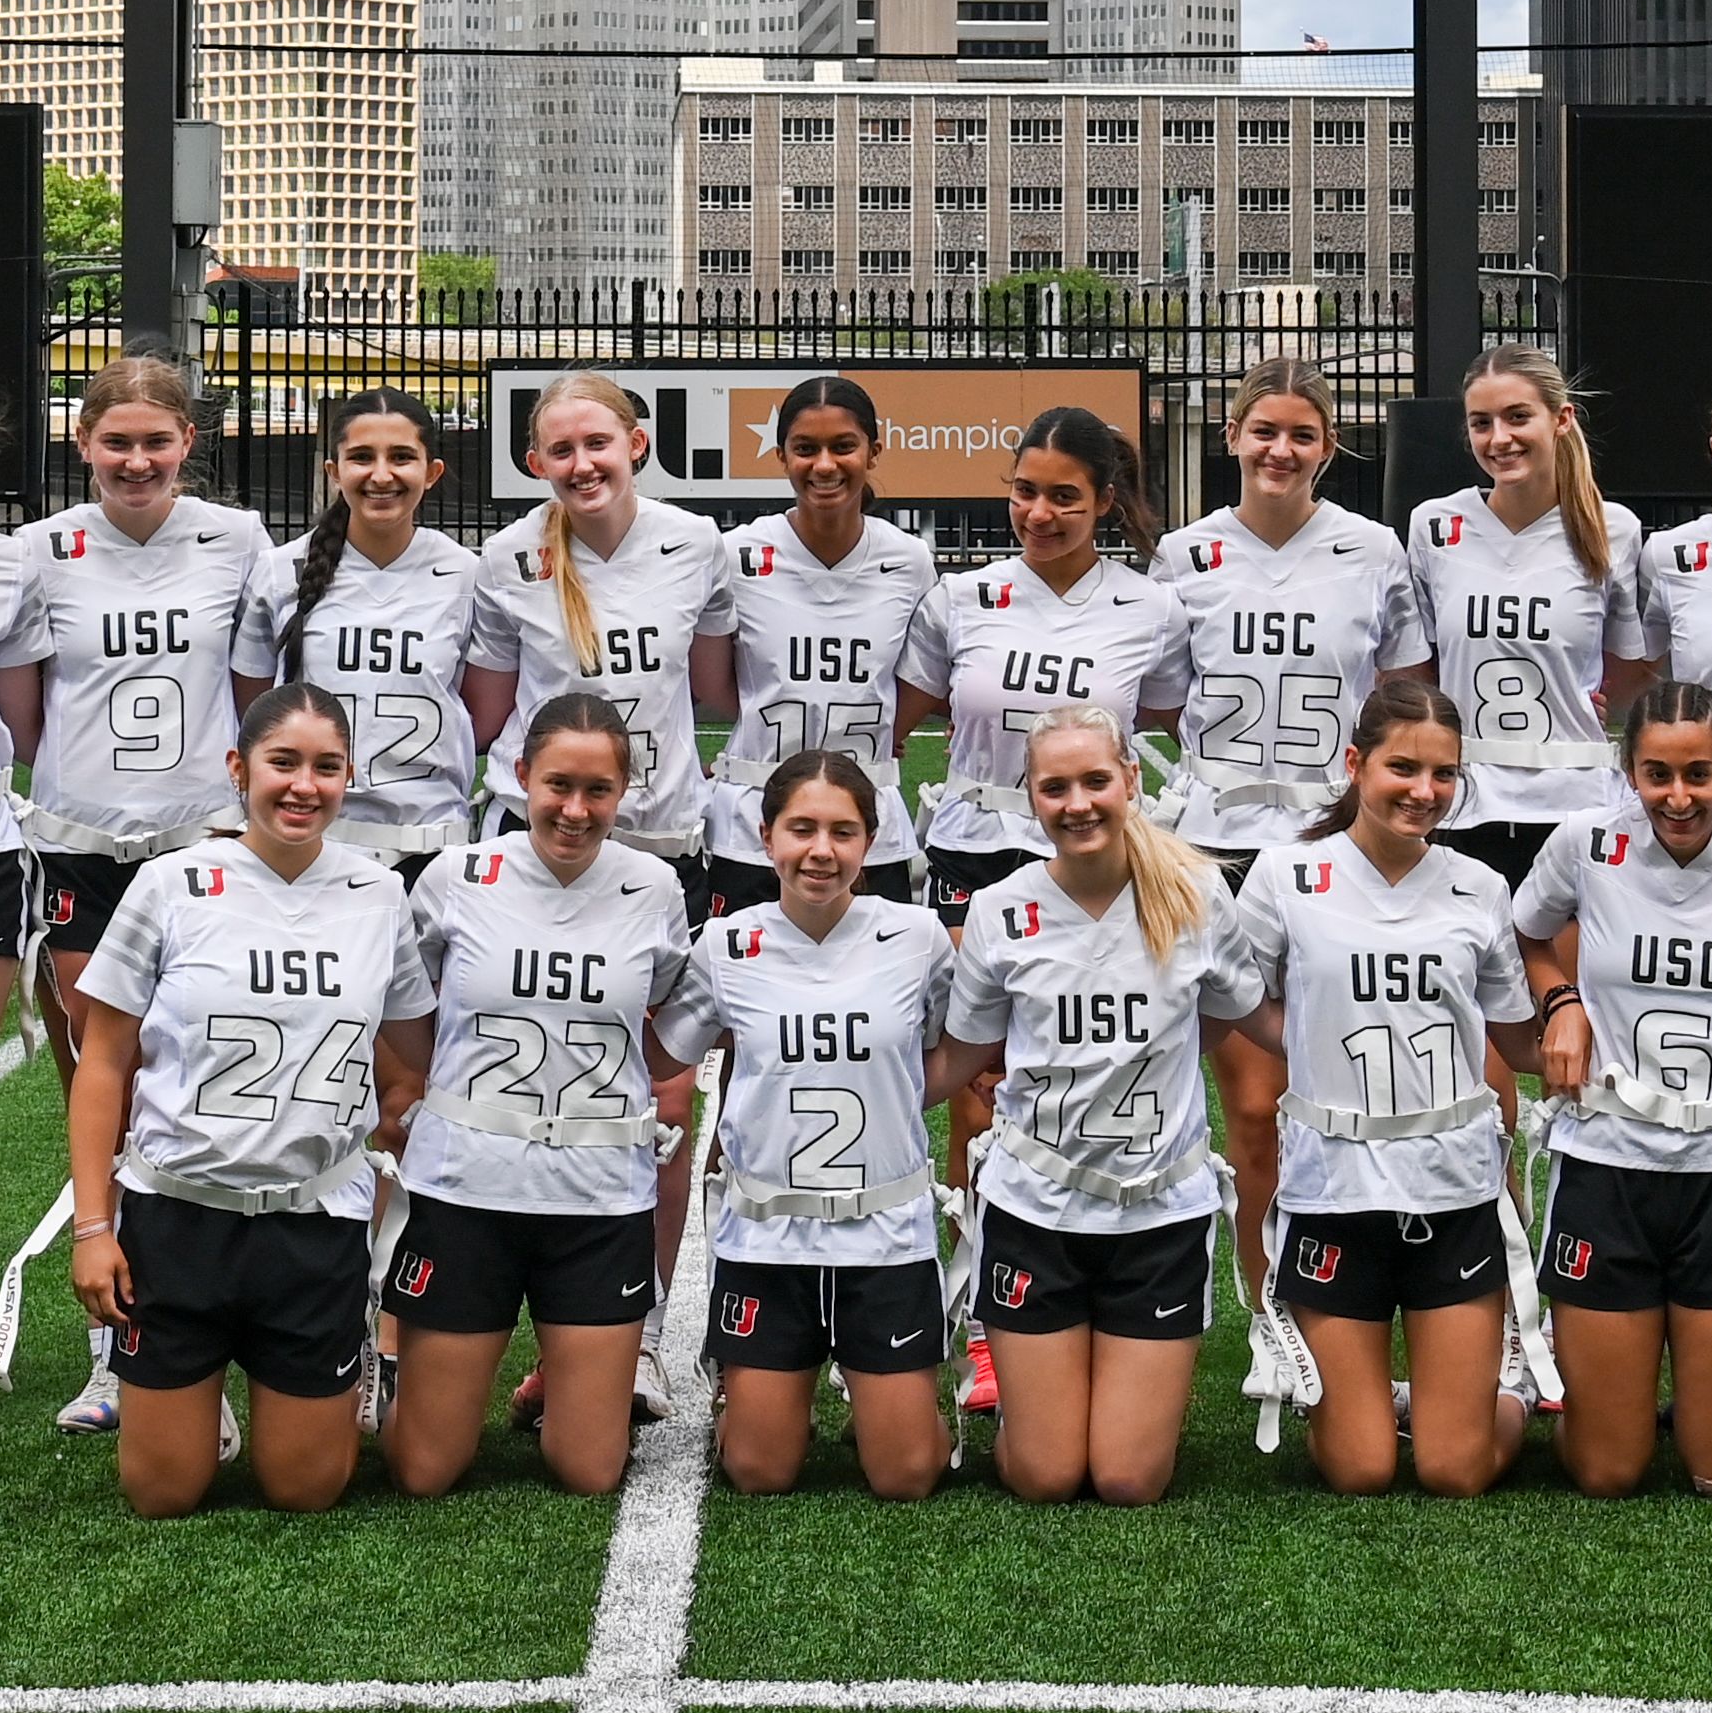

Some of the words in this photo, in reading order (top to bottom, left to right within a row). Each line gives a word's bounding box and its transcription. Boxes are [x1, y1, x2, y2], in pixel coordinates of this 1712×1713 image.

[103, 609, 189, 657] USC
[1233, 612, 1315, 656] USC
[1467, 595, 1551, 640] USC
[337, 627, 424, 674] USC
[790, 637, 871, 683] USC
[1002, 650, 1094, 698] USC
[109, 676, 184, 771] 9
[1200, 674, 1342, 767] 25
[1474, 657, 1552, 743] 8
[249, 949, 341, 997] USC
[512, 949, 606, 1003] USC
[1351, 953, 1442, 1002] USC
[780, 1013, 870, 1062] USC
[1058, 993, 1148, 1044] USC
[196, 1015, 370, 1126] 24
[468, 1013, 630, 1119] 22
[1341, 1023, 1456, 1116] 11
[1634, 1009, 1712, 1100] 6
[1023, 1057, 1163, 1155] 14
[789, 1088, 865, 1190] 2
